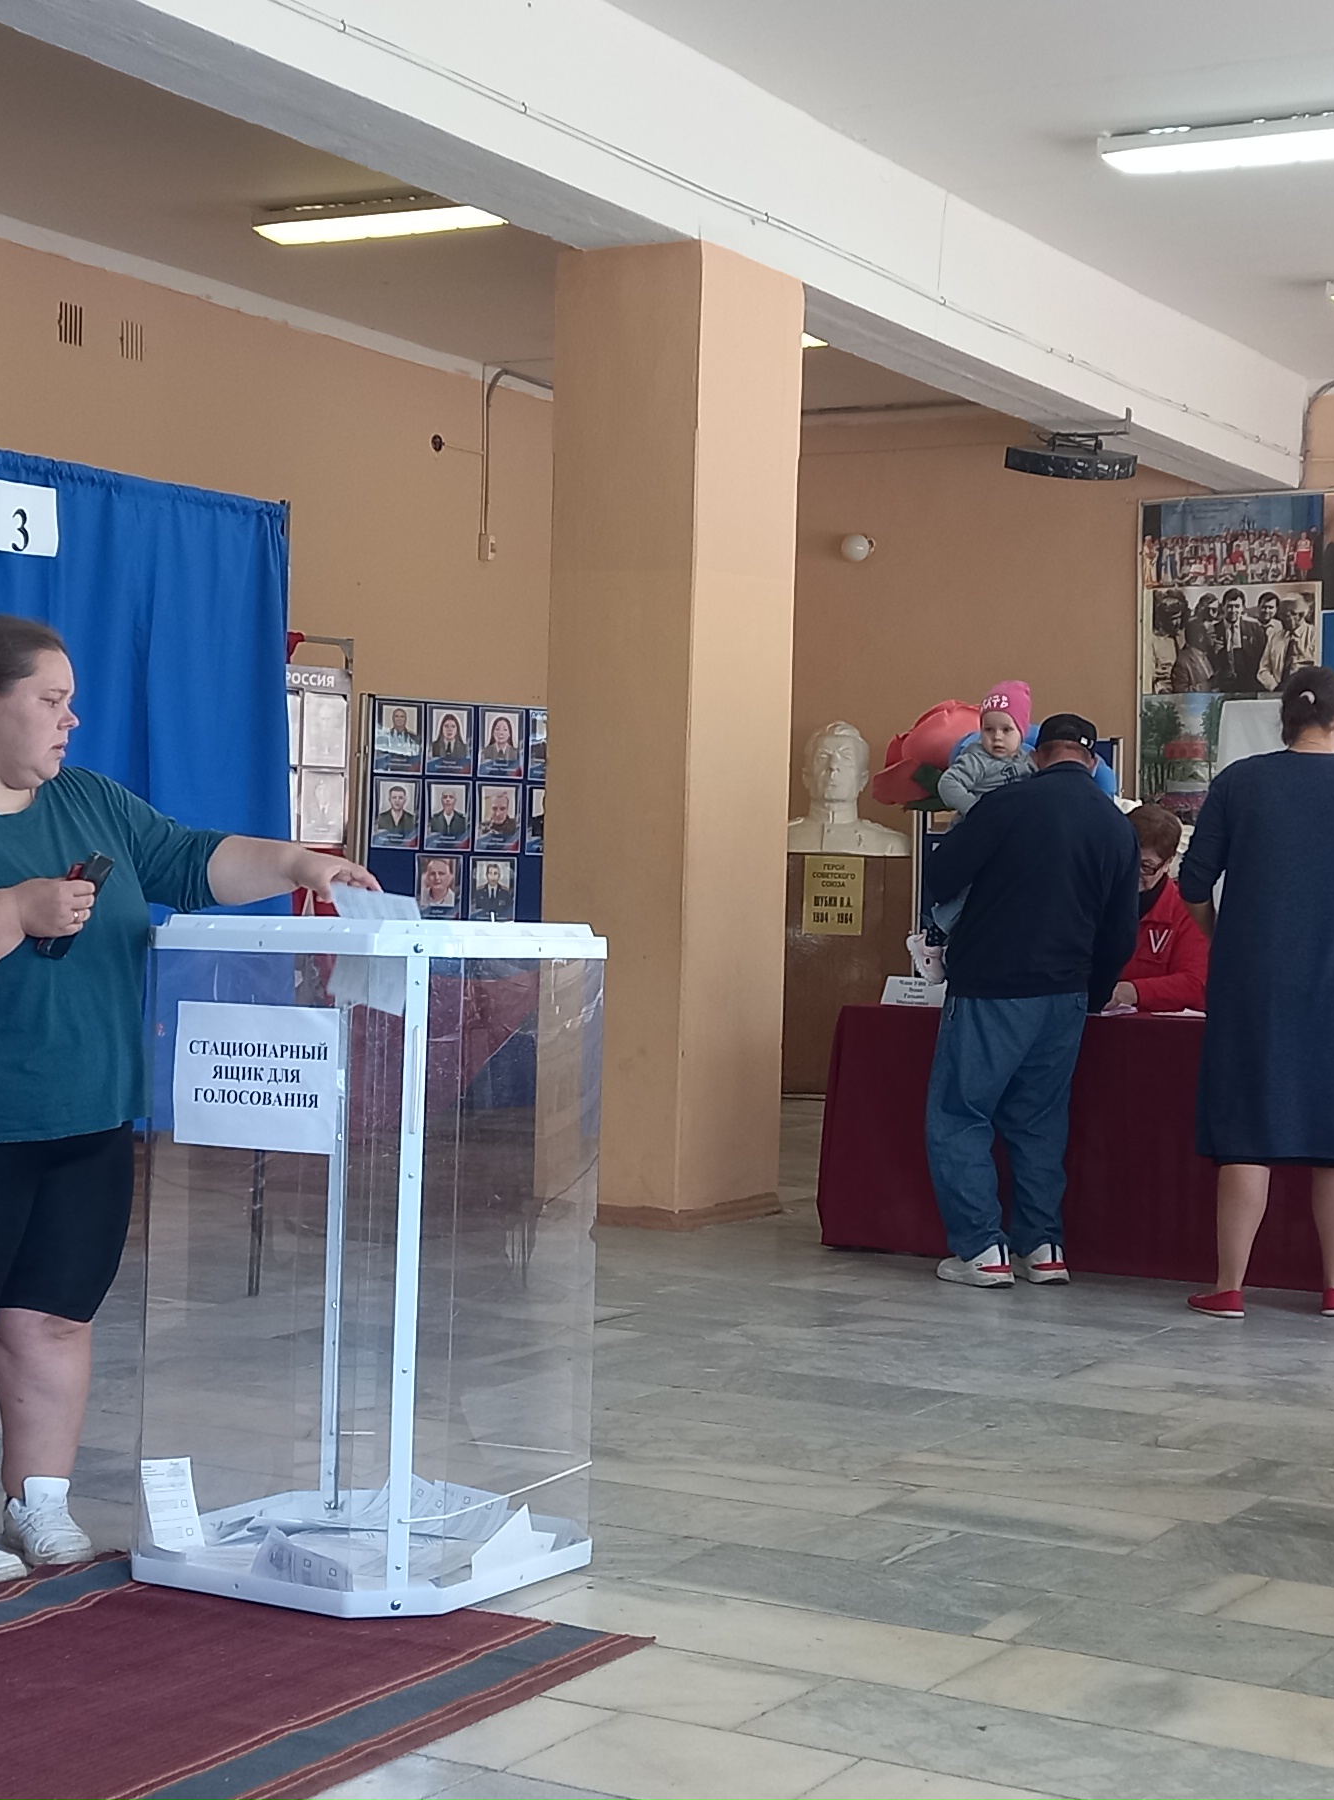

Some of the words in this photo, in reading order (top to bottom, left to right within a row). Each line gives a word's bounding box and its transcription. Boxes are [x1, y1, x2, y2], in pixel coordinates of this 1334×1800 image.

[11, 508, 29, 552] 3
[812, 872, 856, 880] СОВЕТСКОГО
[189, 1040, 328, 1061] СТАЦИОНАРНЫЙ
[212, 1065, 264, 1083] ЯЩИК
[267, 1067, 301, 1085] ДЛЯ
[193, 1087, 319, 1109] ГОЛОСОВАНИЯ
